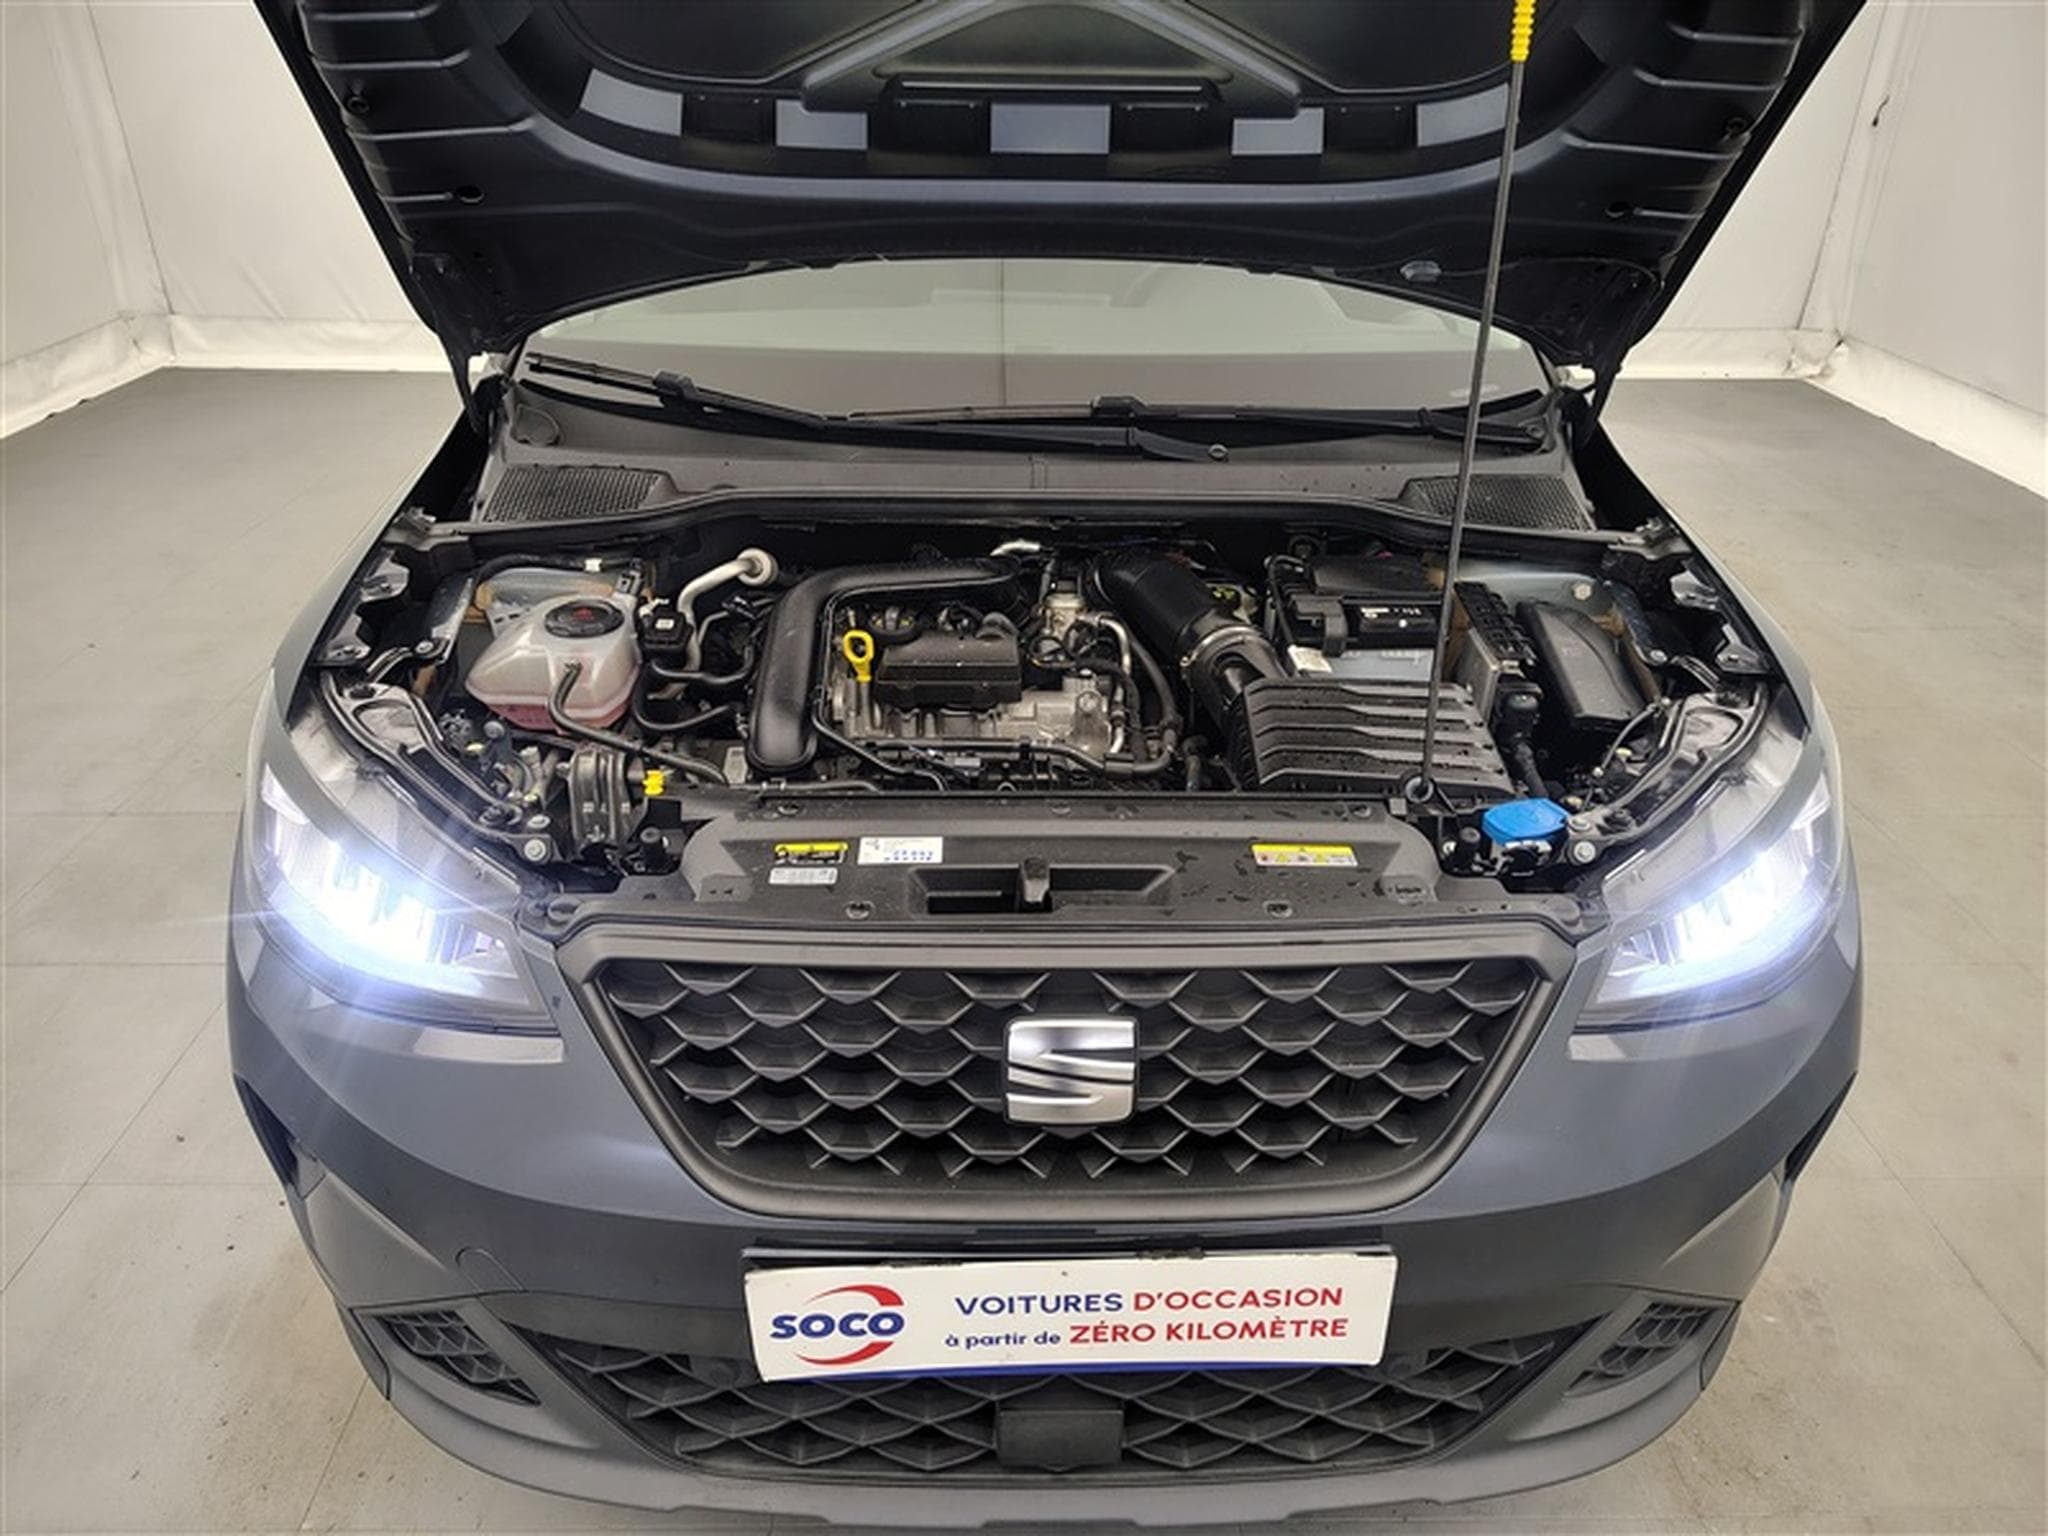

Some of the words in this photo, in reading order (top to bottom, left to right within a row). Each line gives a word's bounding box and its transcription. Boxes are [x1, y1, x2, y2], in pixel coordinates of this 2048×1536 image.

[955, 1293, 1123, 1315] VOITURES
[1134, 1287, 1343, 1311] D'OCCASION
[770, 1312, 905, 1339] SOCO
[945, 1334, 959, 1347] à
[965, 1332, 1027, 1350] partir
[1033, 1331, 1061, 1345] de
[1069, 1320, 1156, 1343] ZÉRO
[1166, 1315, 1348, 1342] KILOMÈTRE
